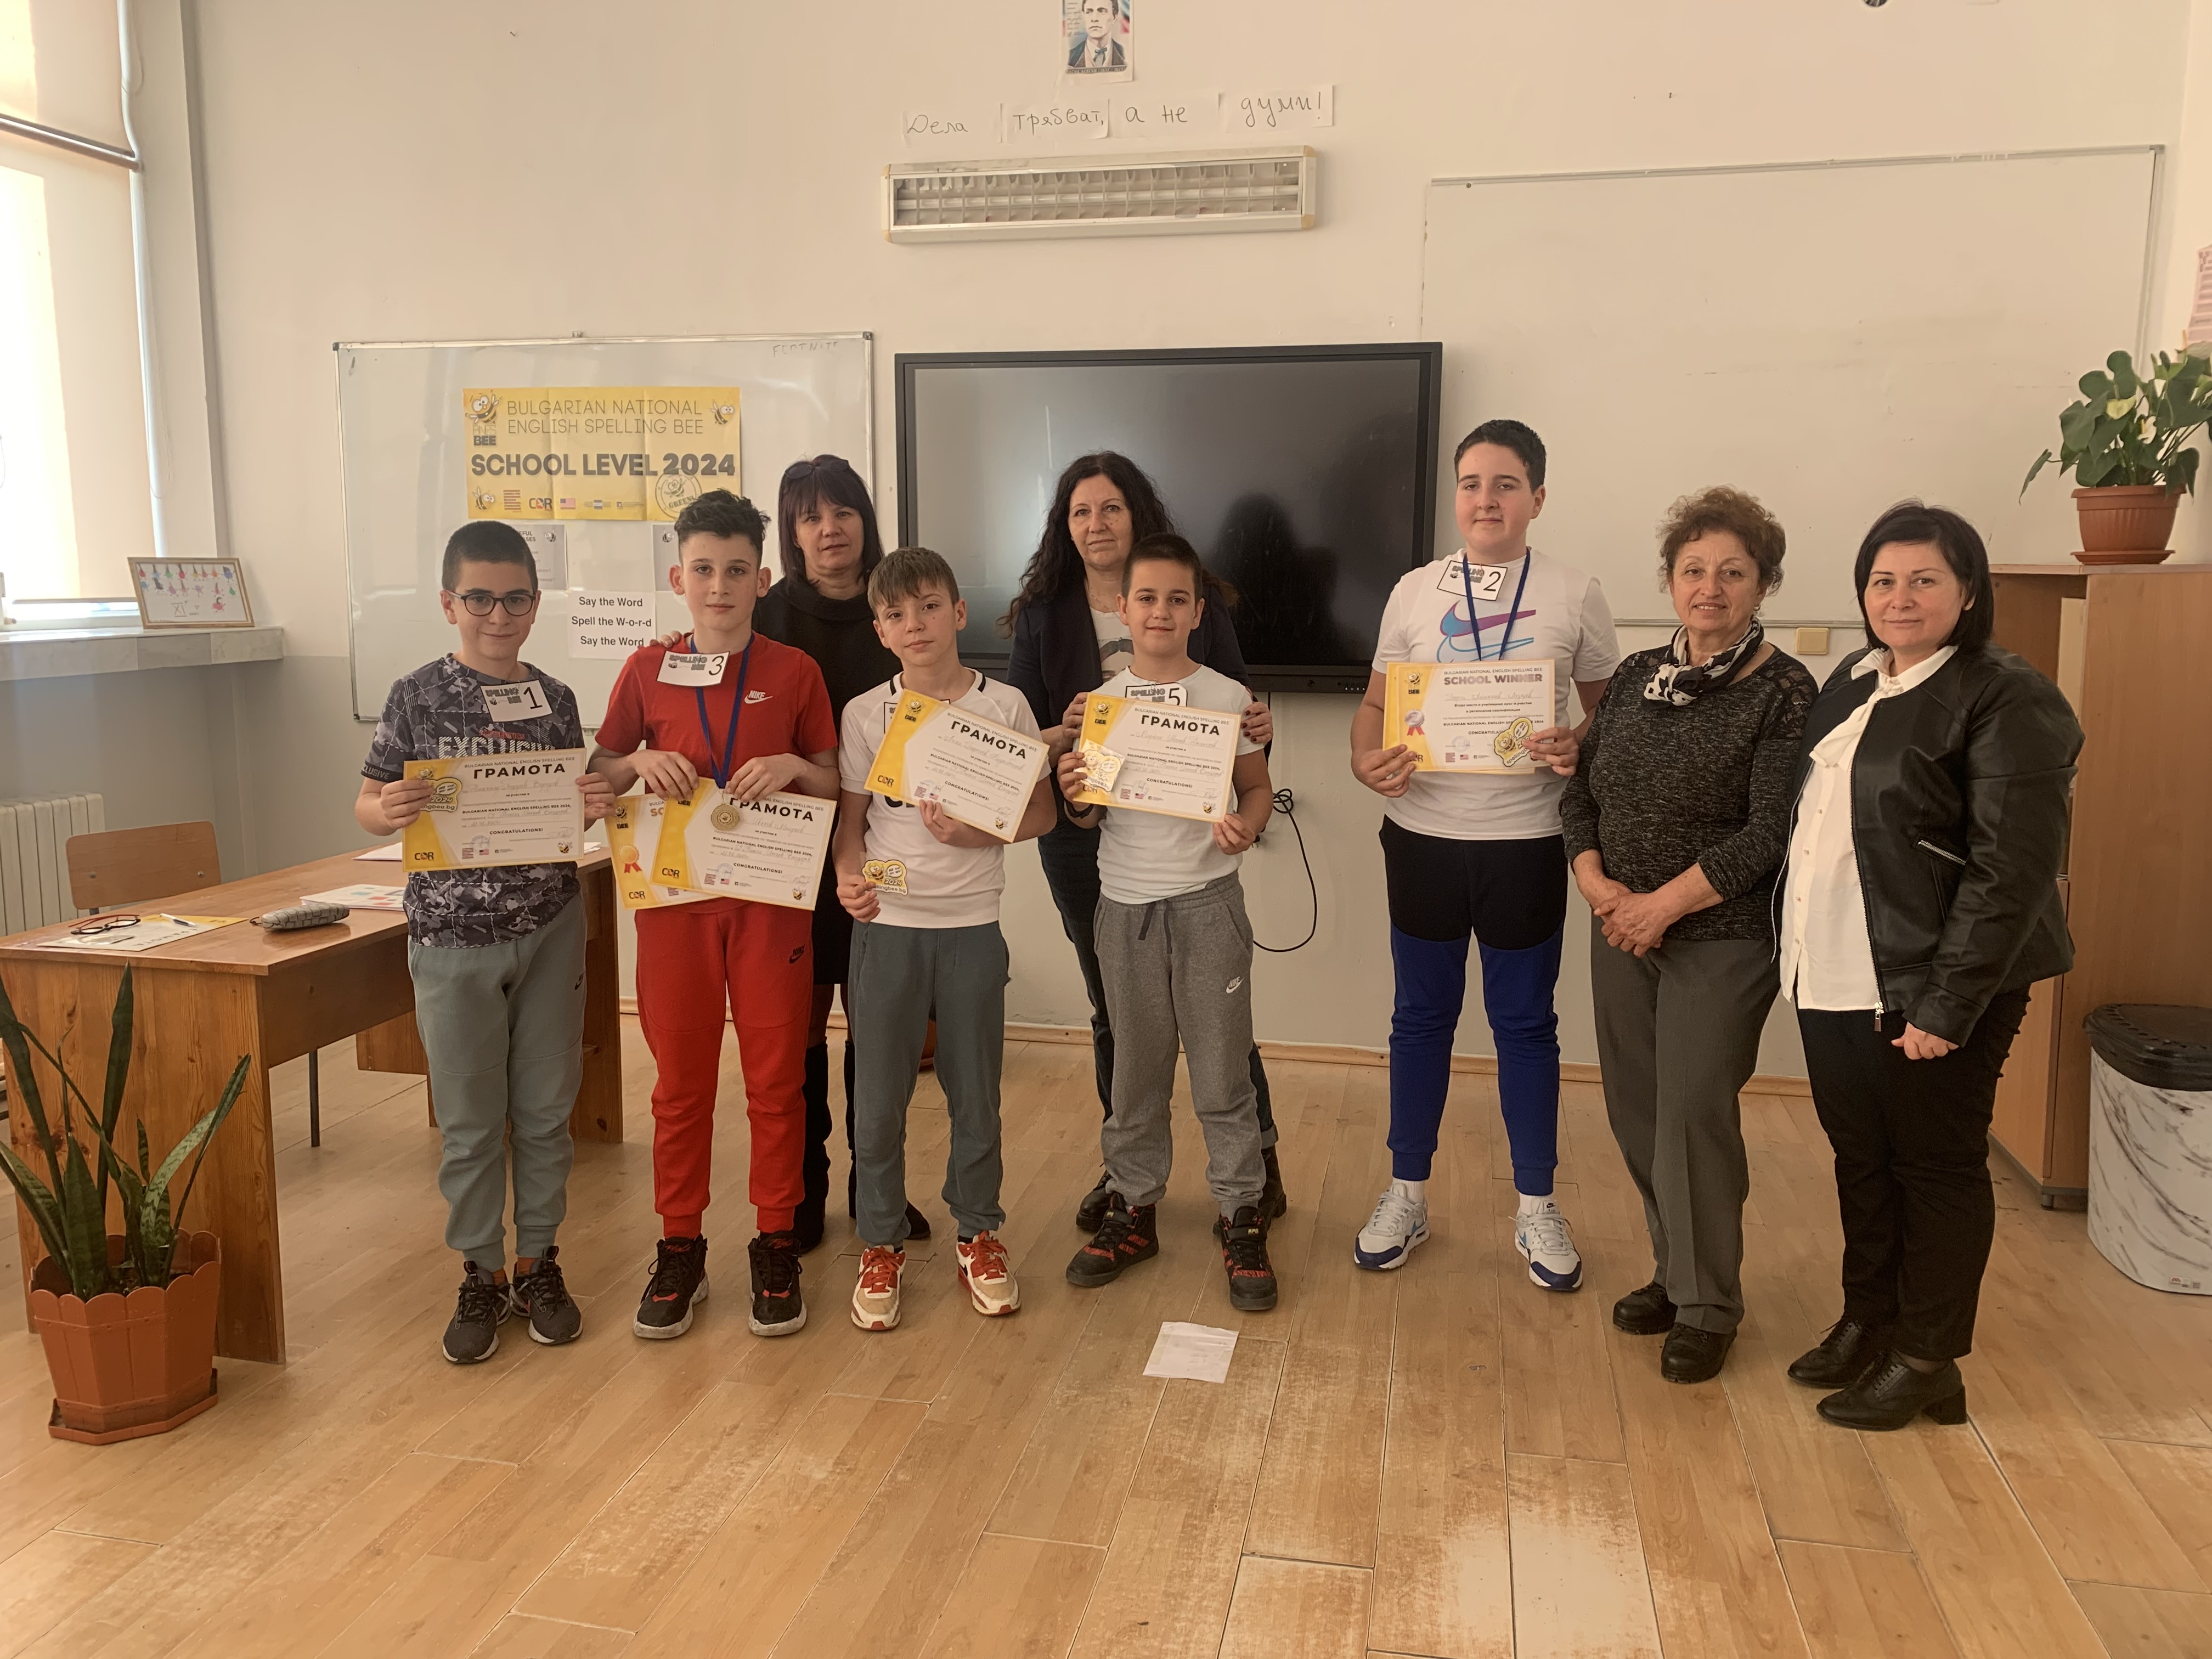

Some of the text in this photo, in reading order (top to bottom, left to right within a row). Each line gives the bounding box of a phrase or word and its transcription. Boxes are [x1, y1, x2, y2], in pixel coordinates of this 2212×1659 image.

[907, 114, 968, 134] Дела
[1125, 106, 1146, 122] а
[1162, 105, 1188, 123] не
[1241, 92, 1321, 127] думи!
[507, 400, 702, 415] BULGARIAN NATIONAL
[508, 419, 703, 434] ENGLISH SPELLING BEE
[473, 436, 496, 445] BEE
[471, 453, 736, 476] SCHOOL LEVEL 2024
[1483, 571, 1501, 592] 2
[579, 596, 642, 608] Say the Word
[572, 616, 651, 627] Spell the W-o-r-d
[580, 636, 644, 647] Say the Word
[669, 654, 708, 663] SPELLING
[708, 655, 724, 675] 3
[1444, 674, 1542, 685] SCHOOL WINNER
[523, 686, 543, 709] 1
[748, 690, 766, 699] NIKE
[1130, 688, 1165, 696] SPELLING
[1169, 687, 1180, 706] 5
[947, 713, 971, 724] BULGARIAN
[972, 722, 991, 732] NATIONAL
[992, 730, 1009, 740] ENGLISH
[1009, 737, 1028, 748] SPELLING
[1141, 714, 1220, 736] ГРАМОТА
[951, 720, 1026, 759] ГРАМОТА
[473, 763, 566, 779] ГРАМОТА
[930, 753, 951, 763] BULGARIAN
[952, 760, 969, 770] NATIONAL
[970, 769, 985, 777] ENGLISH
[1147, 778, 1192, 788] CONGRATULATIONS!
[945, 781, 989, 801] CONGRATULATIONS!
[733, 862, 782, 874] CONGRATULATIONS!
[1229, 977, 1240, 988] NIKE
